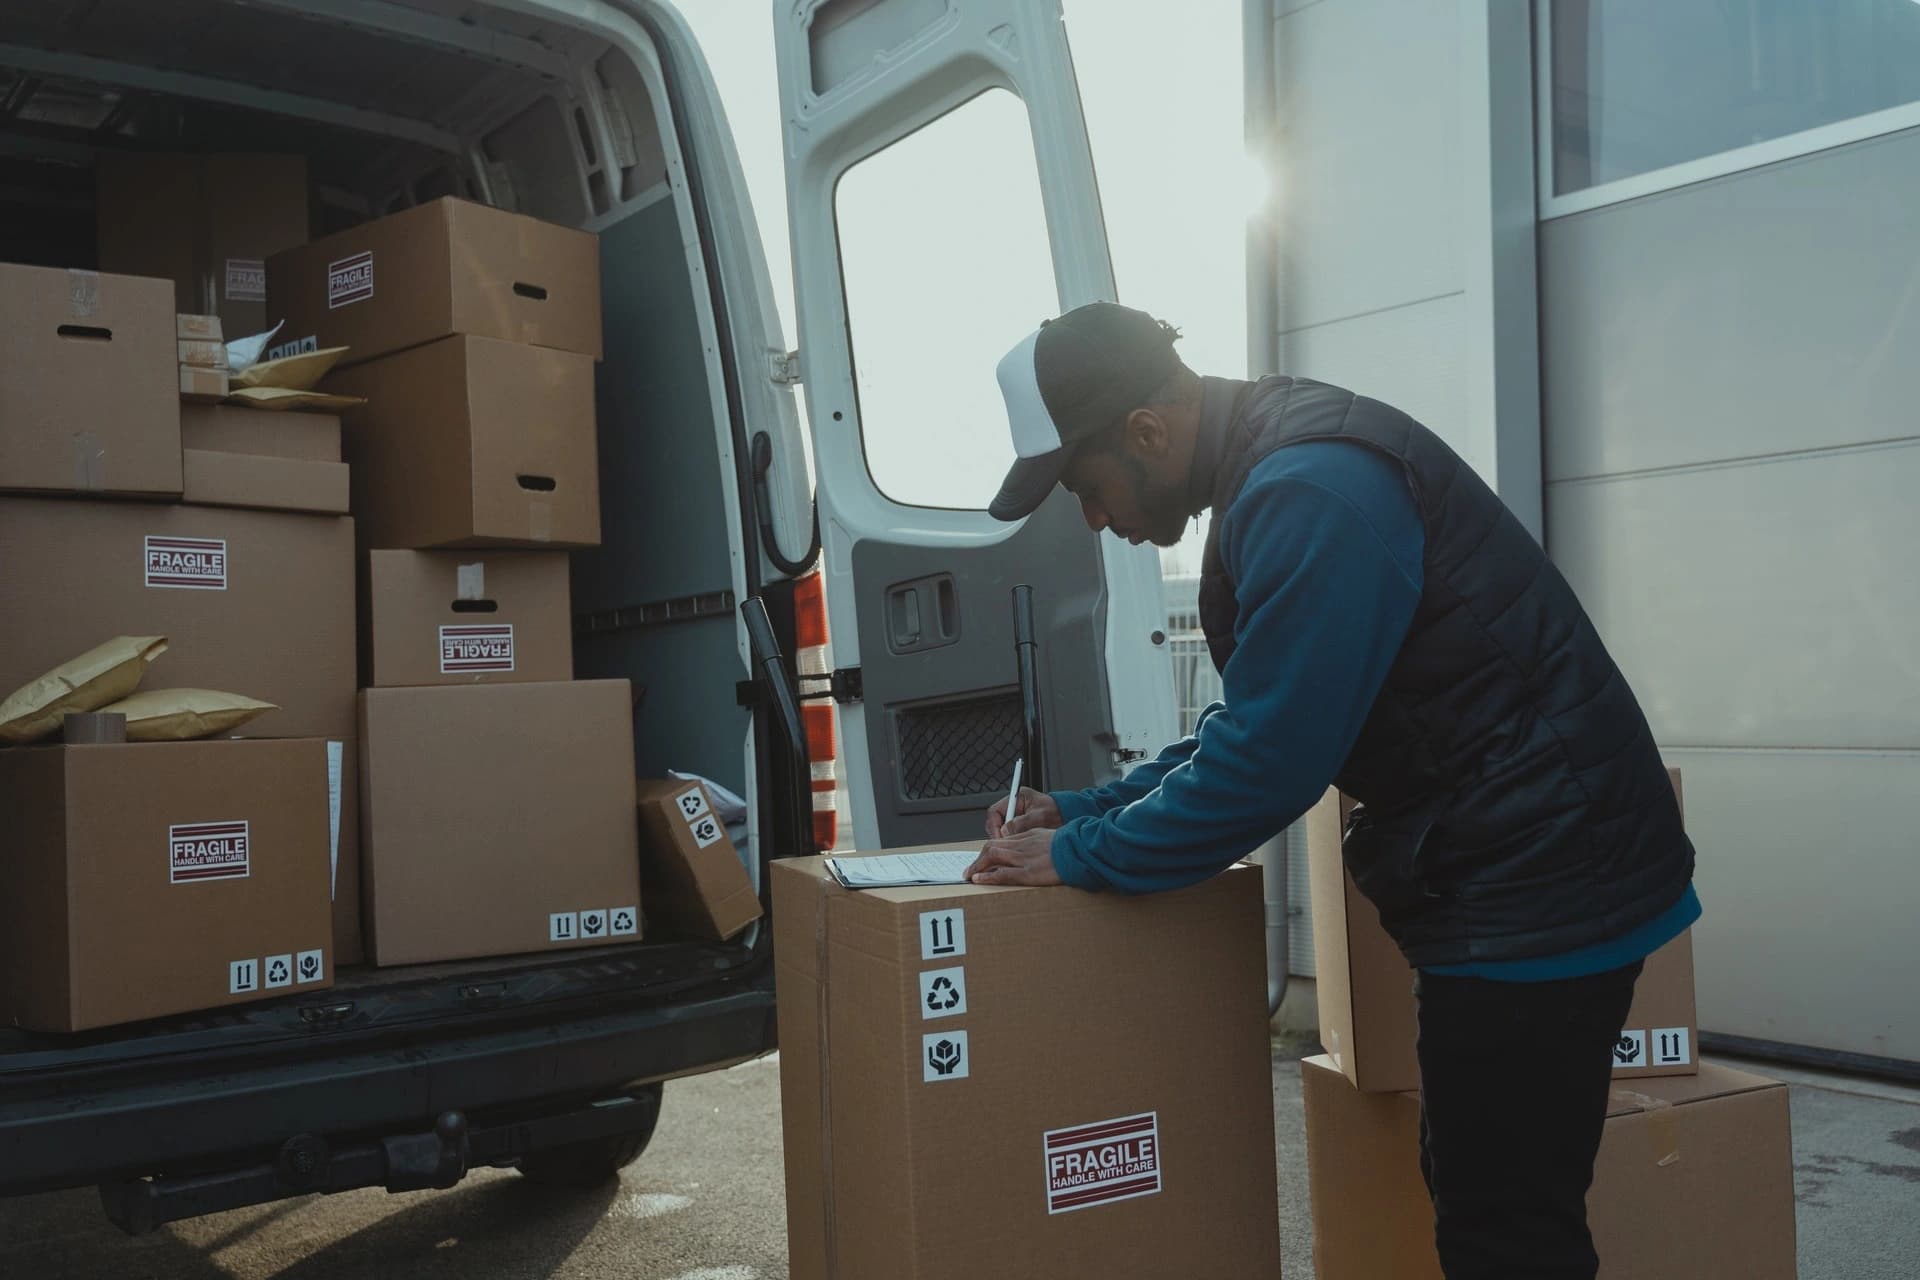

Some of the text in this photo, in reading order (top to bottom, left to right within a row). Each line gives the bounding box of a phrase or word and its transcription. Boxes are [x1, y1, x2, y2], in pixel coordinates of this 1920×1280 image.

[230, 271, 265, 285] FRAG
[331, 266, 370, 288] FRAGILE
[149, 551, 222, 568] FRAGILE
[149, 565, 180, 573] HANDLE
[201, 567, 222, 575] CARE
[444, 645, 510, 658] FRAGILE
[173, 839, 245, 858] FRAGILE
[174, 853, 245, 866] HANDLE WITH CARE
[1050, 1139, 1153, 1178] FRAGILE
[1052, 1159, 1153, 1189] HANDLE WITH CARE
